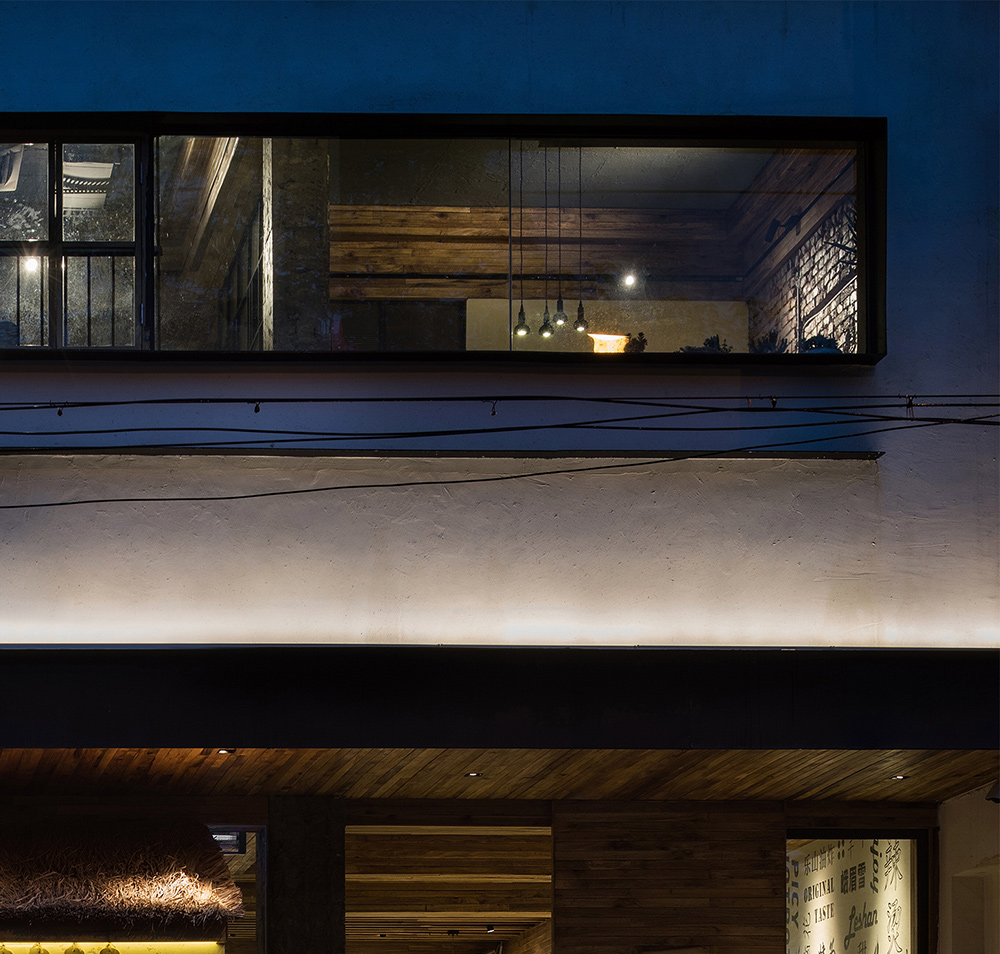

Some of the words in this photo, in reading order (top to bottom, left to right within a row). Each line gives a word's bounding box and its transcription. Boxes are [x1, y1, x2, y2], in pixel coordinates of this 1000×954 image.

[803, 877, 835, 904] ORIGINAL
[814, 902, 835, 924] TASTE
[843, 901, 878, 951] Leshan
